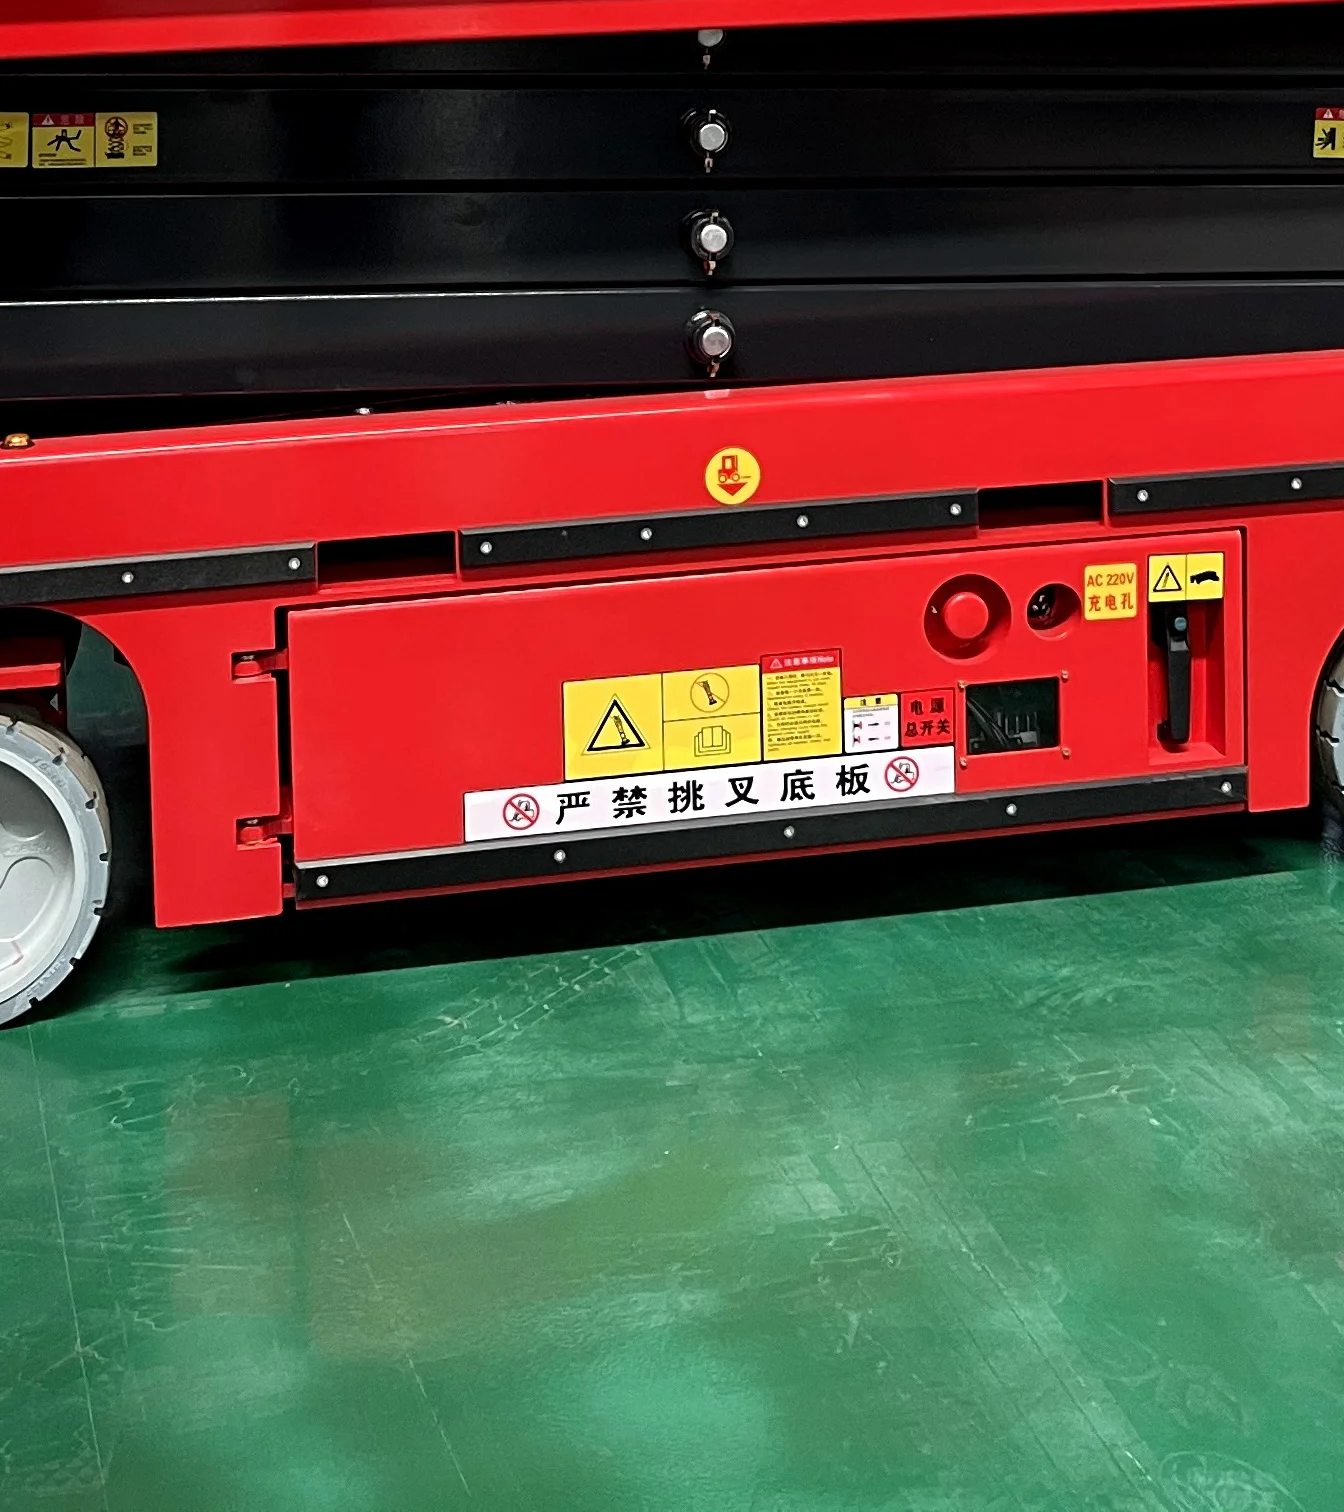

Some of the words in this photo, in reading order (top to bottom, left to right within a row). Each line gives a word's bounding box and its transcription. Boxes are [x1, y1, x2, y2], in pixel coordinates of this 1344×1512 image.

[1087, 573, 1103, 587] AC
[1106, 571, 1134, 586] 220V
[1088, 591, 1134, 613] 充电孔
[905, 718, 951, 738] 总开关
[556, 763, 871, 825] 严禁挑叉底板
